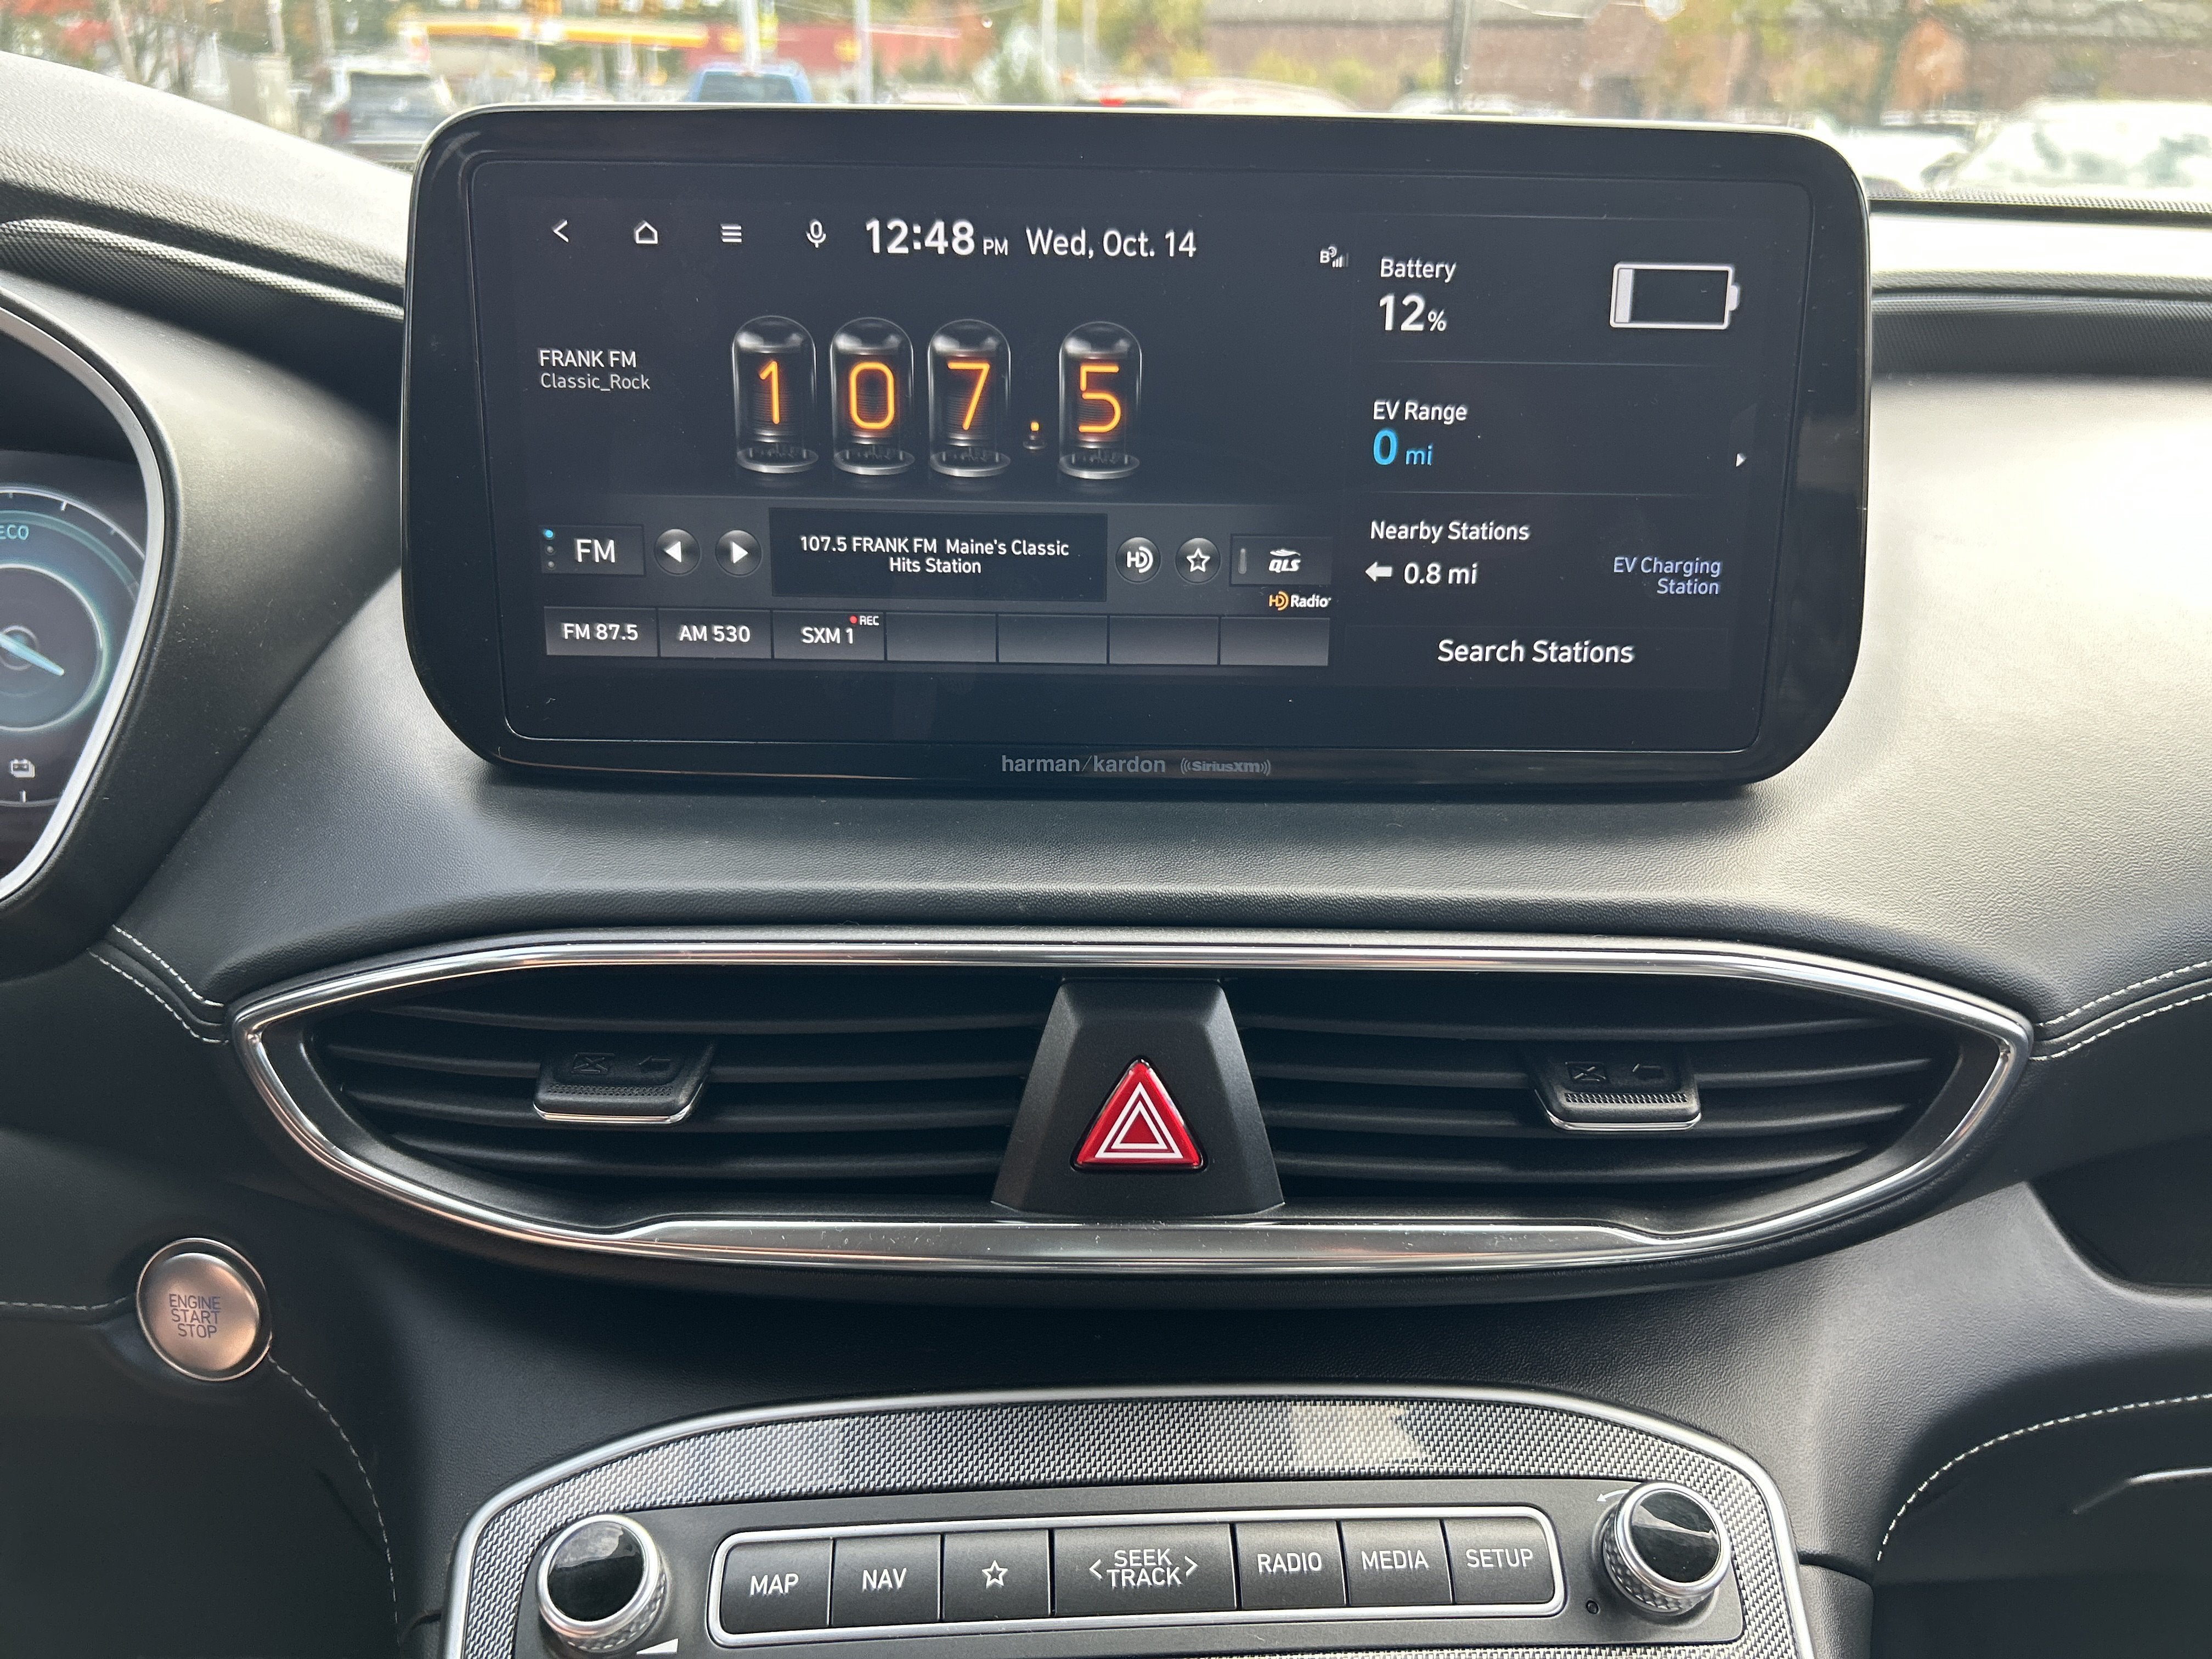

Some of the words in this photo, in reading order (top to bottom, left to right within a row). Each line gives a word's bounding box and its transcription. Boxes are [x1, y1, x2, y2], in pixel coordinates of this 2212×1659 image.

[865, 218, 975, 256] 12:48
[983, 238, 1008, 256] PM
[1025, 228, 1094, 259] Wed,
[1102, 230, 1155, 256] Oct.
[1165, 230, 1197, 257] 14
[1379, 258, 1457, 283] Battery
[539, 349, 604, 368] FRANK
[608, 351, 636, 368] FM
[540, 373, 651, 391] Classic_Rock
[1373, 402, 1398, 421] EV
[1404, 401, 1469, 425] Range
[1373, 428, 1397, 465] 0
[1405, 445, 1433, 465] mi
[1370, 521, 1443, 544] Nearby
[1447, 523, 1530, 541] Stations
[575, 538, 616, 563] FM
[800, 535, 847, 552] 107.5
[853, 538, 908, 553] FRANK
[913, 539, 937, 553] FM
[946, 539, 1007, 556] Maine's
[1011, 540, 1069, 557] Classic
[889, 557, 921, 573] Hits
[926, 558, 981, 574] Station
[1269, 558, 1301, 573] QLS
[1403, 563, 1441, 585] 0.8
[1448, 562, 1477, 585] mi
[1613, 557, 1637, 574] EV
[1640, 556, 1721, 578] Charging
[1657, 579, 1719, 595] Station
[1290, 592, 1328, 608] Radio
[860, 616, 879, 625] REC
[563, 624, 590, 640] FM
[596, 624, 639, 641] 87.5
[679, 626, 708, 642] AM
[713, 626, 751, 643] 530
[802, 628, 841, 644] SXM
[846, 628, 854, 644] 1
[1438, 639, 1525, 662] Search
[1532, 640, 1634, 664] Stations
[169, 1294, 221, 1311] ENGINE
[171, 1308, 219, 1324] START
[178, 1323, 217, 1339] STOP
[1114, 1548, 1172, 1568] SEEK
[1258, 1552, 1322, 1573] RADIO
[1362, 1551, 1429, 1571] MEDIA
[1466, 1549, 1534, 1569] SETUP
[750, 1573, 799, 1595] MAP
[862, 1568, 907, 1590] NAV
[1107, 1567, 1181, 1588] TRACK
